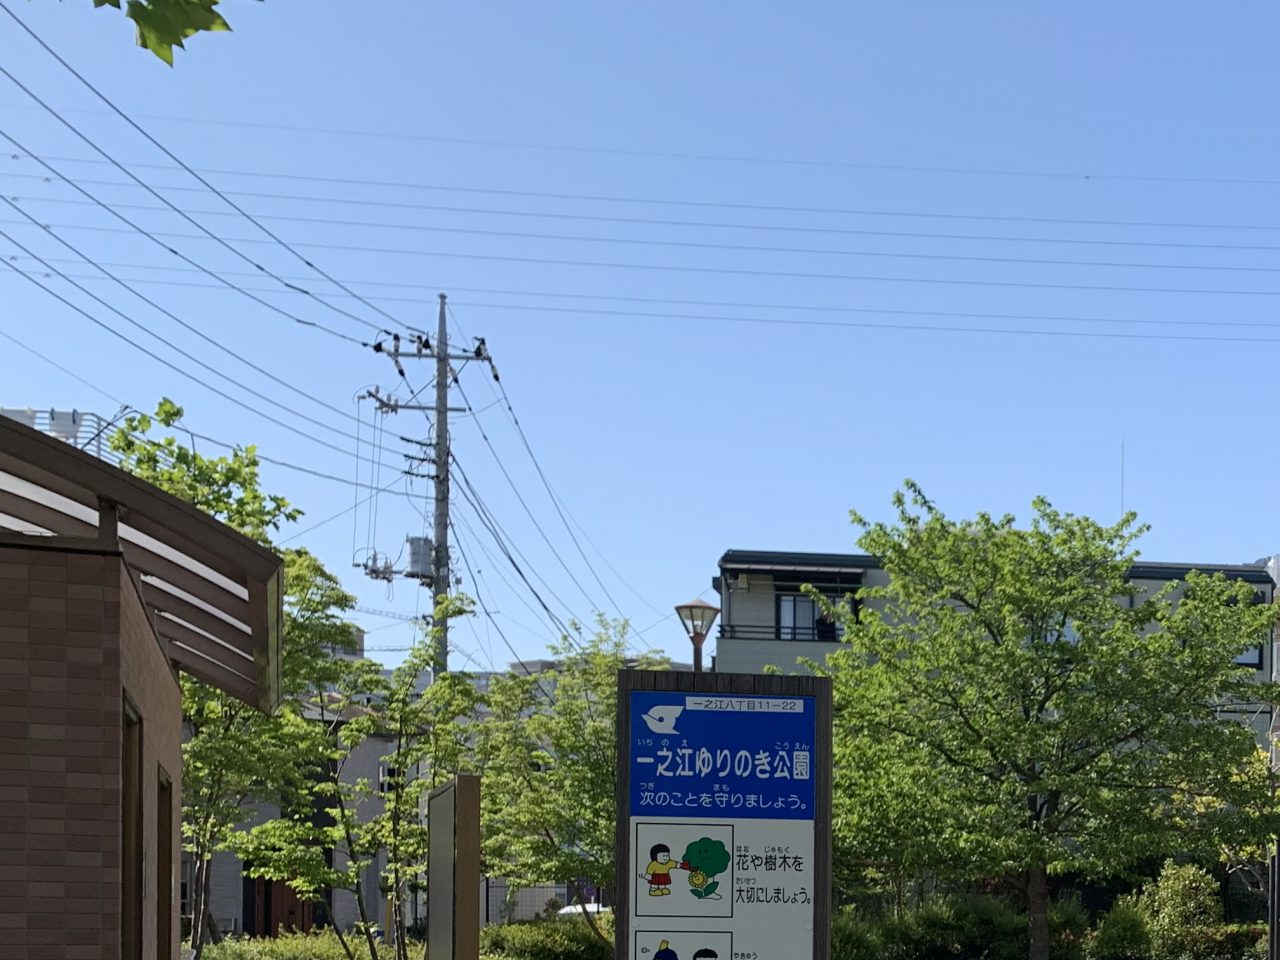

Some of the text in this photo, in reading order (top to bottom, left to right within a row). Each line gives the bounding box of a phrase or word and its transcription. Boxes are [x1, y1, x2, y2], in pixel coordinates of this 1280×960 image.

[637, 747, 809, 779] 一之江ゆりのき公園
[640, 792, 806, 809] 次のことを守りましょう。
[736, 854, 803, 871] 花や樹木を
[736, 887, 810, 904] 大切にしましょう。
